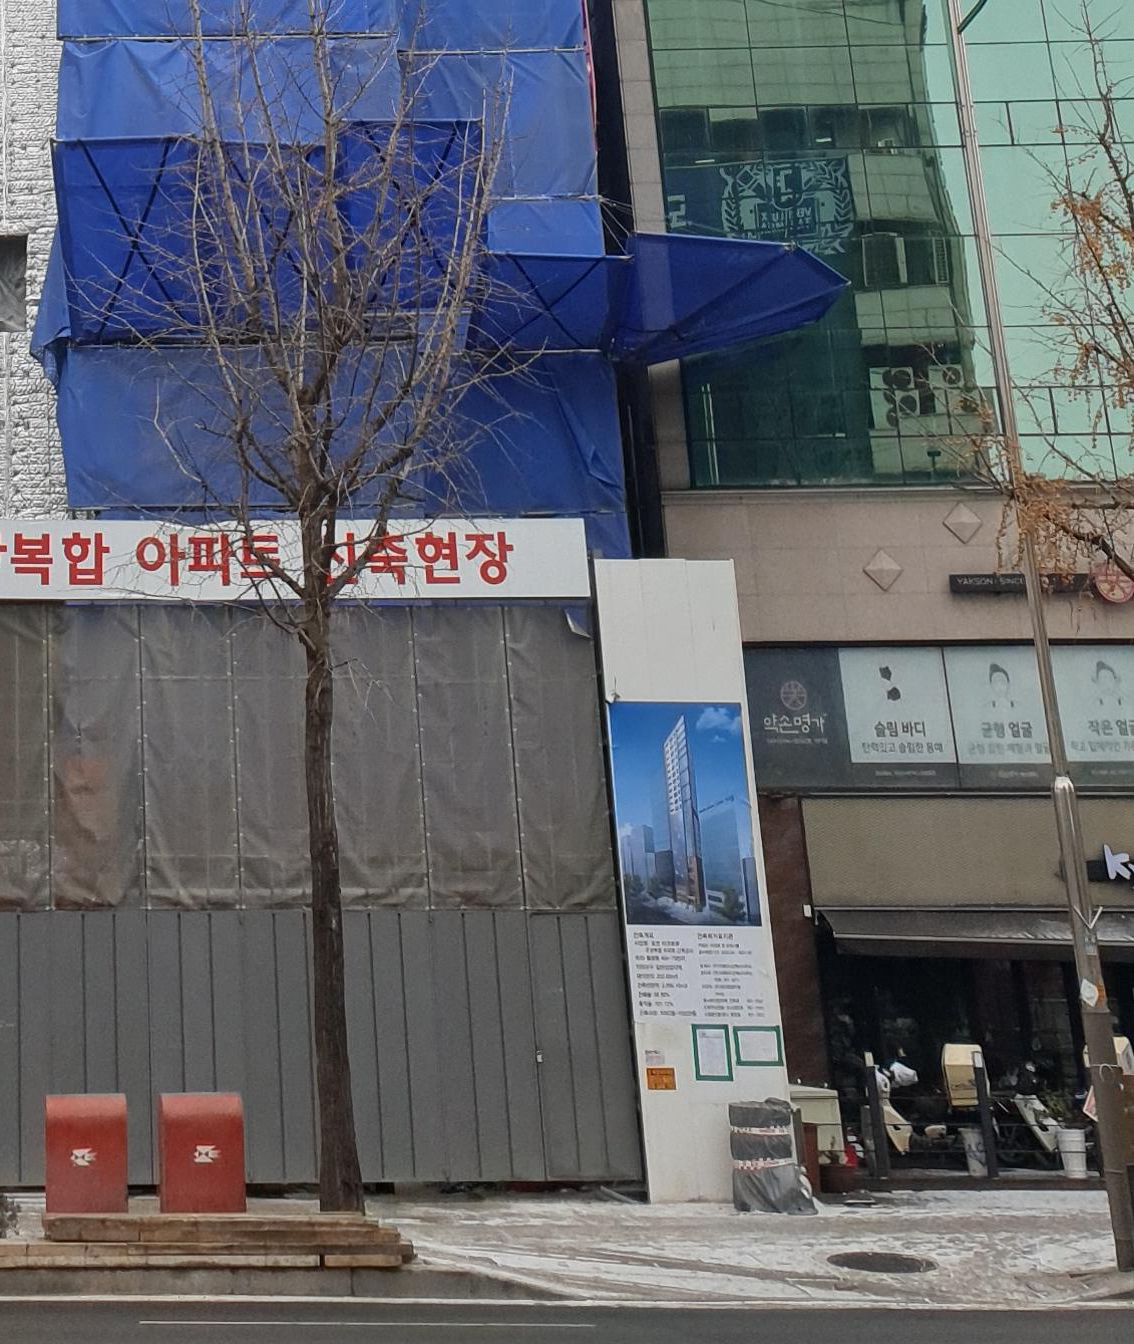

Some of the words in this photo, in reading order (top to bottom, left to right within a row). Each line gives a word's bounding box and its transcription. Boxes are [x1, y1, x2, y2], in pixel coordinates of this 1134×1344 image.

[135, 533, 281, 586] 아파트
[763, 712, 825, 735] 약손명가
[901, 720, 927, 737] 바디
